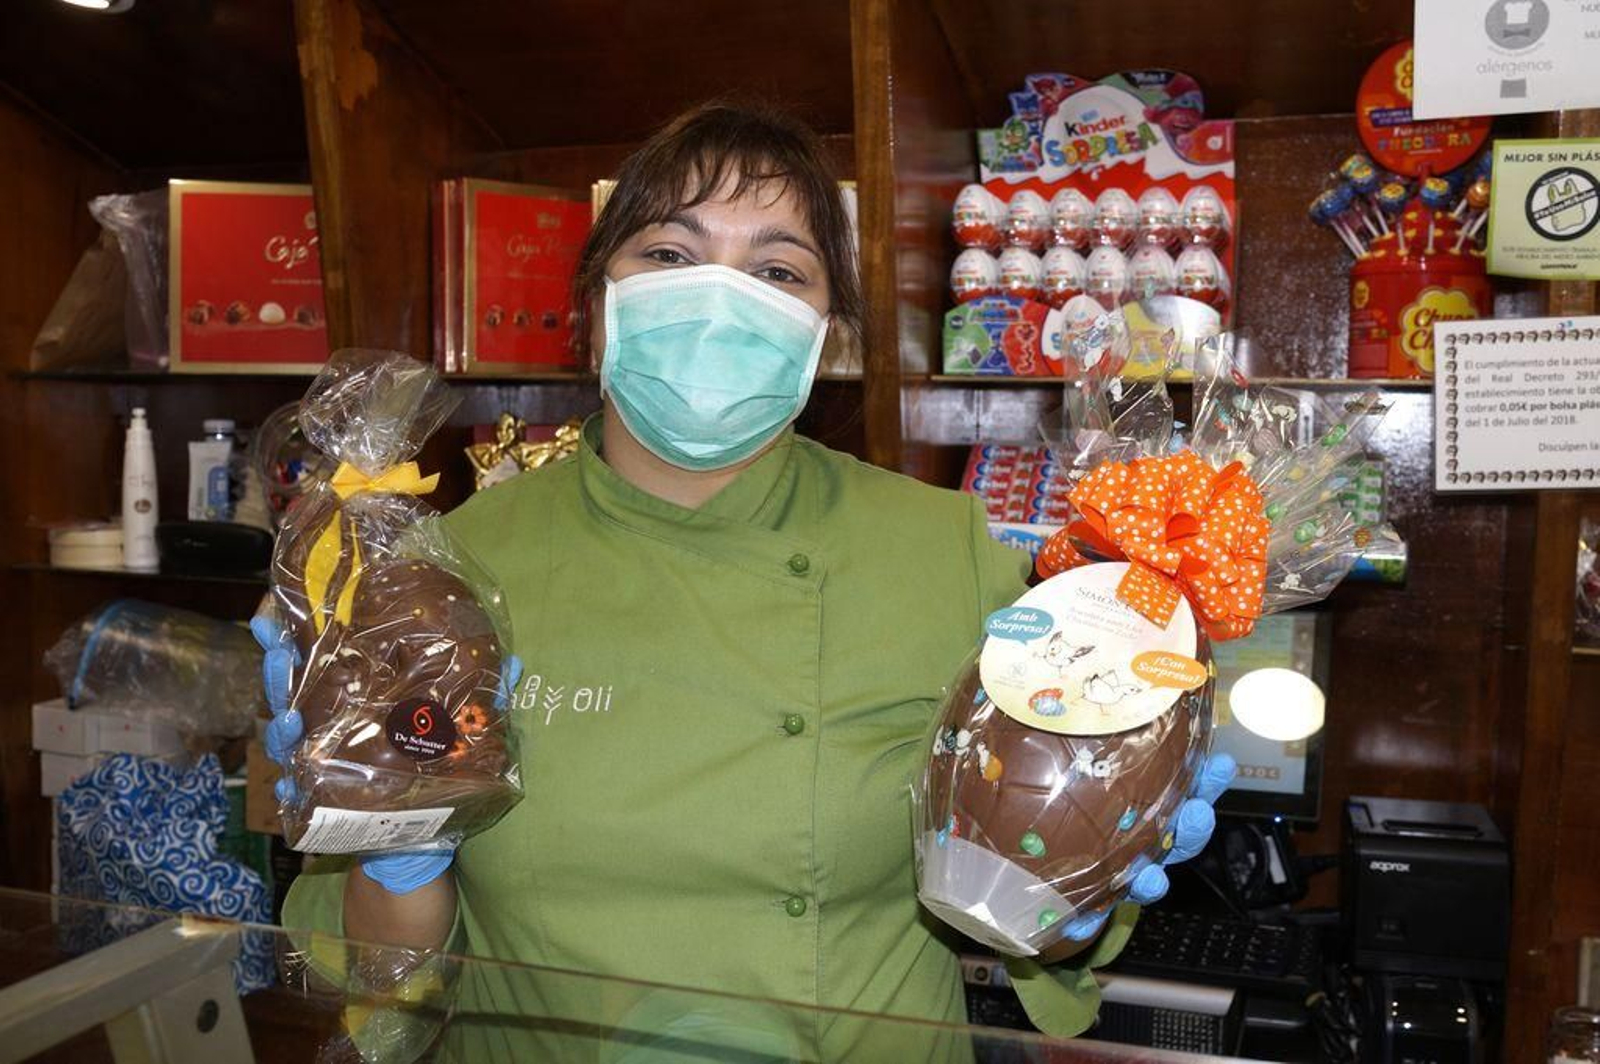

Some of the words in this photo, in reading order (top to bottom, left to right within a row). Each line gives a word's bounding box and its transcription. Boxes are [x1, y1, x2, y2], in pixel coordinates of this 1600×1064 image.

[1476, 59, 1554, 78] alérgenos
[1503, 152, 1543, 163] MEJOR
[1548, 152, 1568, 162] SIN
[264, 234, 309, 270] Caja
[1464, 359, 1474, 370] El
[1475, 358, 1545, 370] cumplimiento
[1547, 356, 1560, 366] de
[1562, 357, 1571, 366] la
[1464, 375, 1480, 384] del
[1491, 373, 1513, 383] Real
[1524, 372, 1565, 382] Decreto
[1464, 388, 1545, 399] establecimiento
[1548, 387, 1575, 396] tiene
[1577, 386, 1587, 395] la
[1464, 402, 1498, 413] cobrar
[1499, 402, 1527, 412] 0,05€
[1530, 402, 1547, 412] por
[1550, 400, 1577, 410] bolsa
[1465, 417, 1480, 428] del
[1491, 417, 1504, 427] de
[1507, 416, 1530, 427] Julio
[1532, 416, 1548, 426] del
[1538, 443, 1587, 453] Disculpen
[1007, 609, 1038, 623] Amb
[989, 618, 1050, 635] Sorpresa!
[1156, 655, 1186, 671] ¡Con
[1137, 660, 1199, 685] Sorpresa!
[573, 686, 612, 712] Oli
[394, 732, 408, 743] De
[409, 736, 446, 751] Schutter
